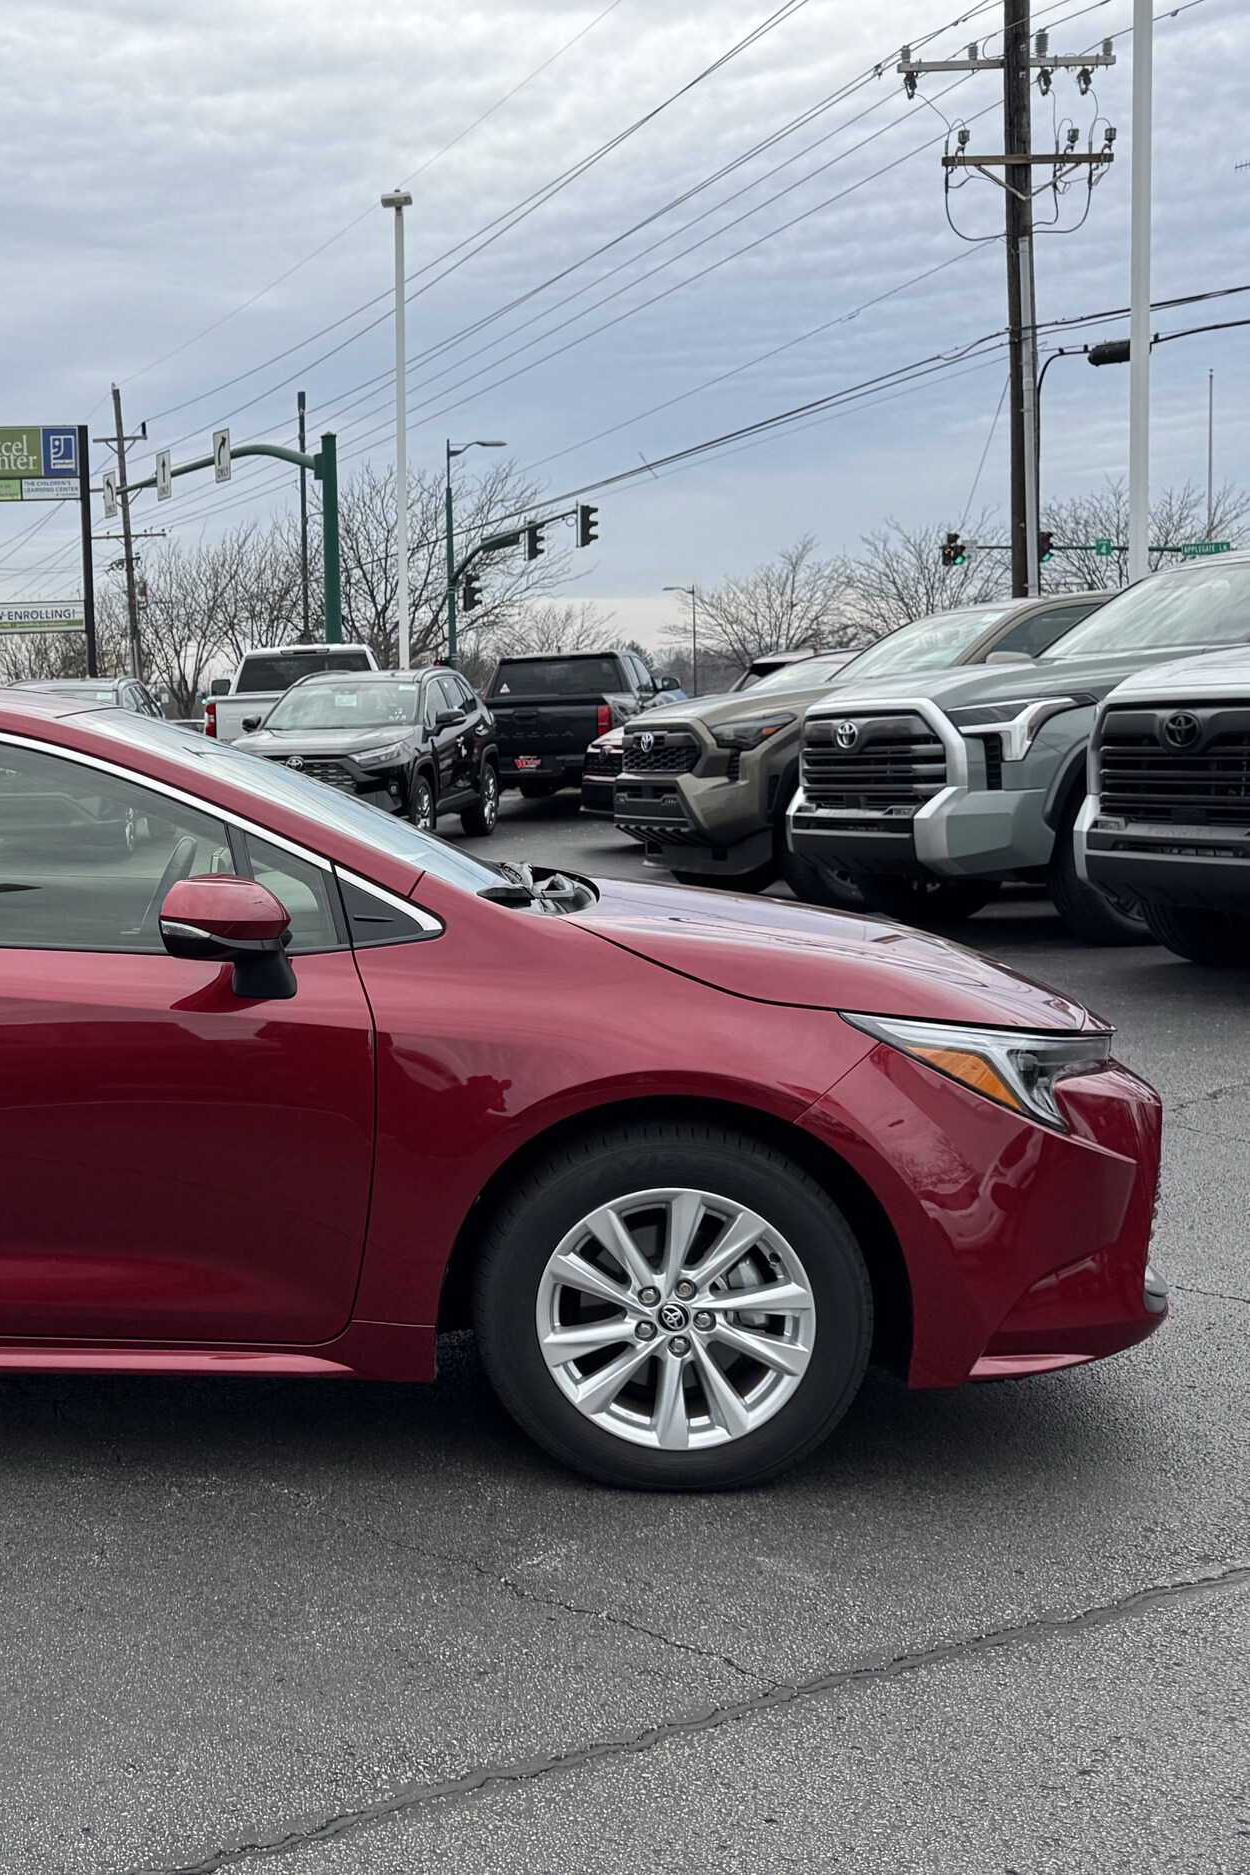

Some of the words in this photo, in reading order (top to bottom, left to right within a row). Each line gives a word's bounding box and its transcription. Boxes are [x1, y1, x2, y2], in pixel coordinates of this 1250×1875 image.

[217, 467, 229, 479] ONLY
[1184, 544, 1215, 553] APPLEGATE
[7, 609, 76, 620] ENROLLING!
